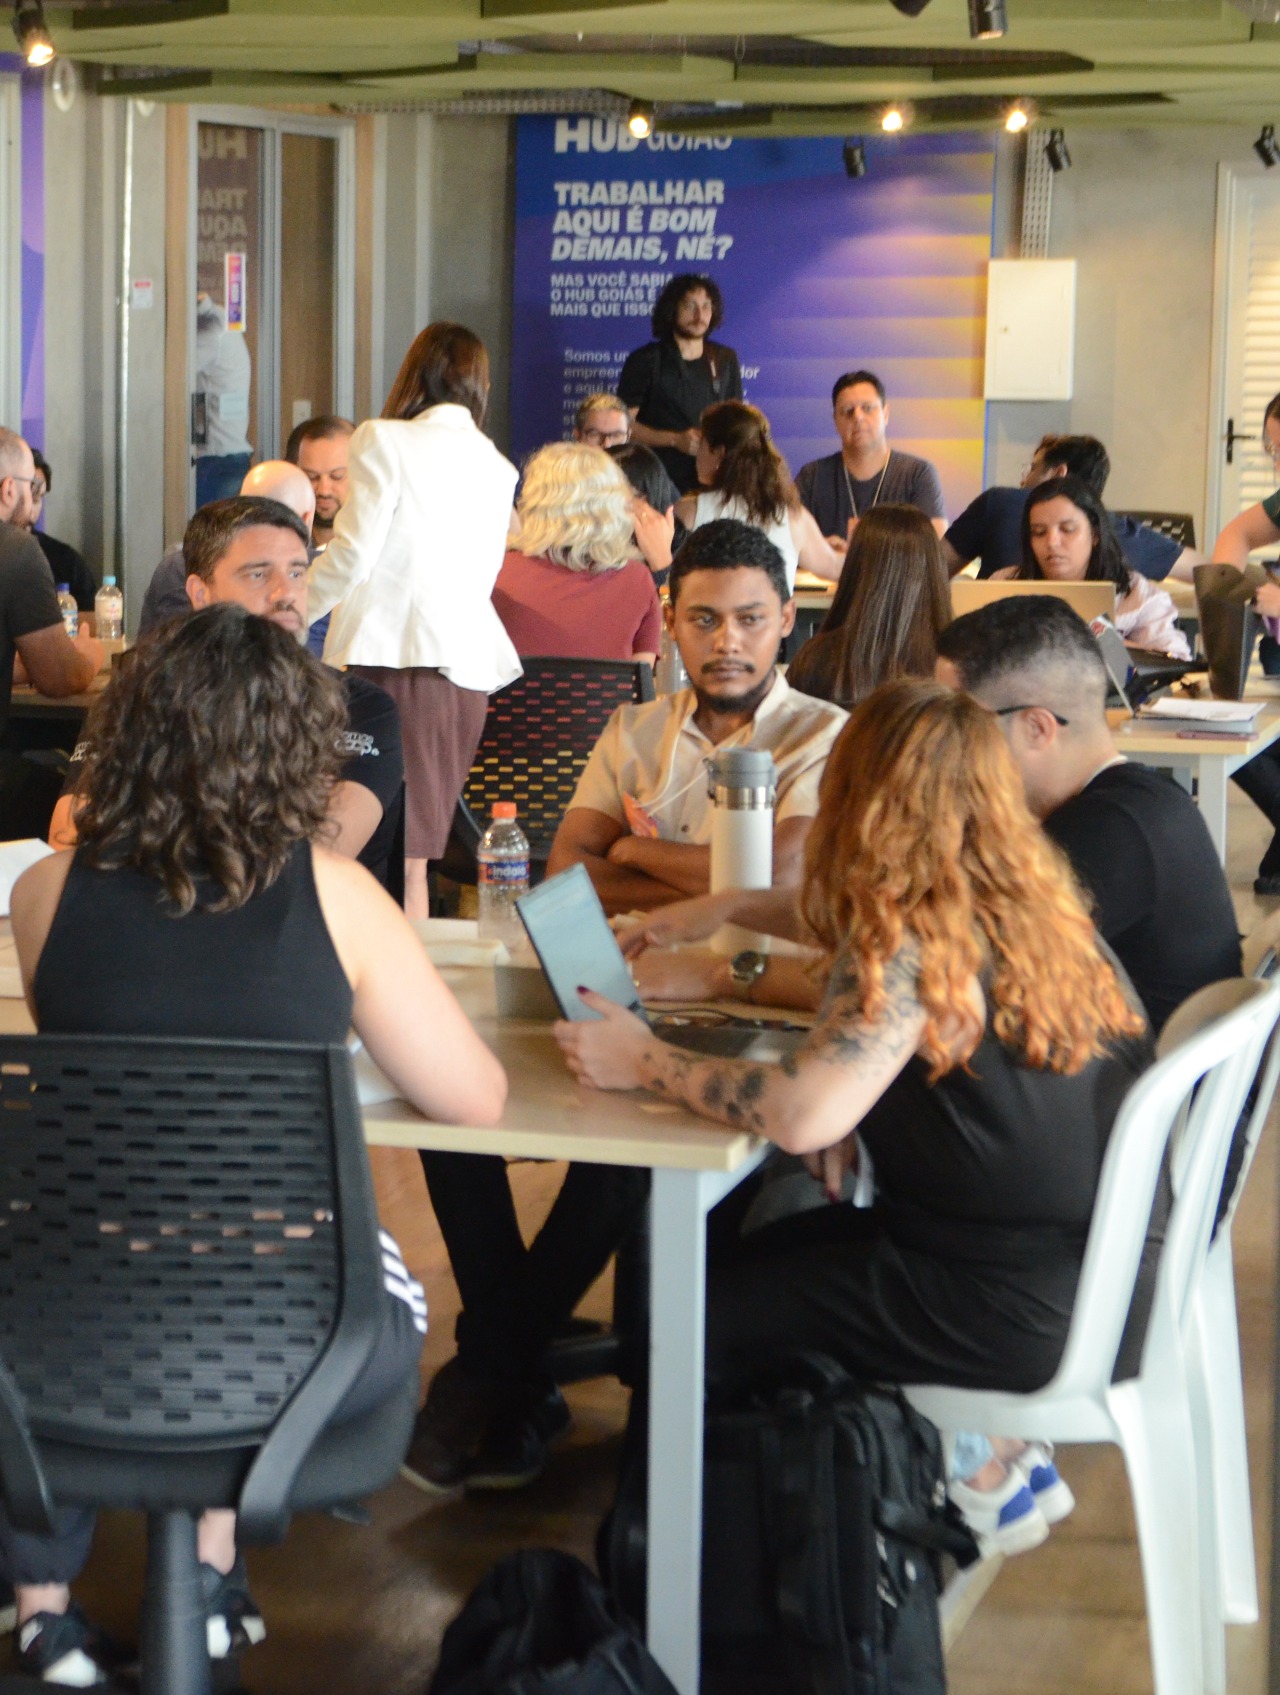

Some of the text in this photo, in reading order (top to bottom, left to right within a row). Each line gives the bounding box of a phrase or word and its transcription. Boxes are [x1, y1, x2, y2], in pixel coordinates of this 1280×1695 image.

[554, 179, 725, 206] TRABALHAR
[553, 203, 718, 239] AQUI É BOM
[551, 231, 734, 265] DEMAIS, NÉ?
[551, 274, 583, 287] MAS
[588, 271, 627, 287] VOCÊ
[551, 289, 561, 302] O
[565, 289, 595, 302] HUB
[551, 303, 588, 316] MAIS
[591, 303, 620, 318] QUE
[564, 348, 610, 362] Somos
